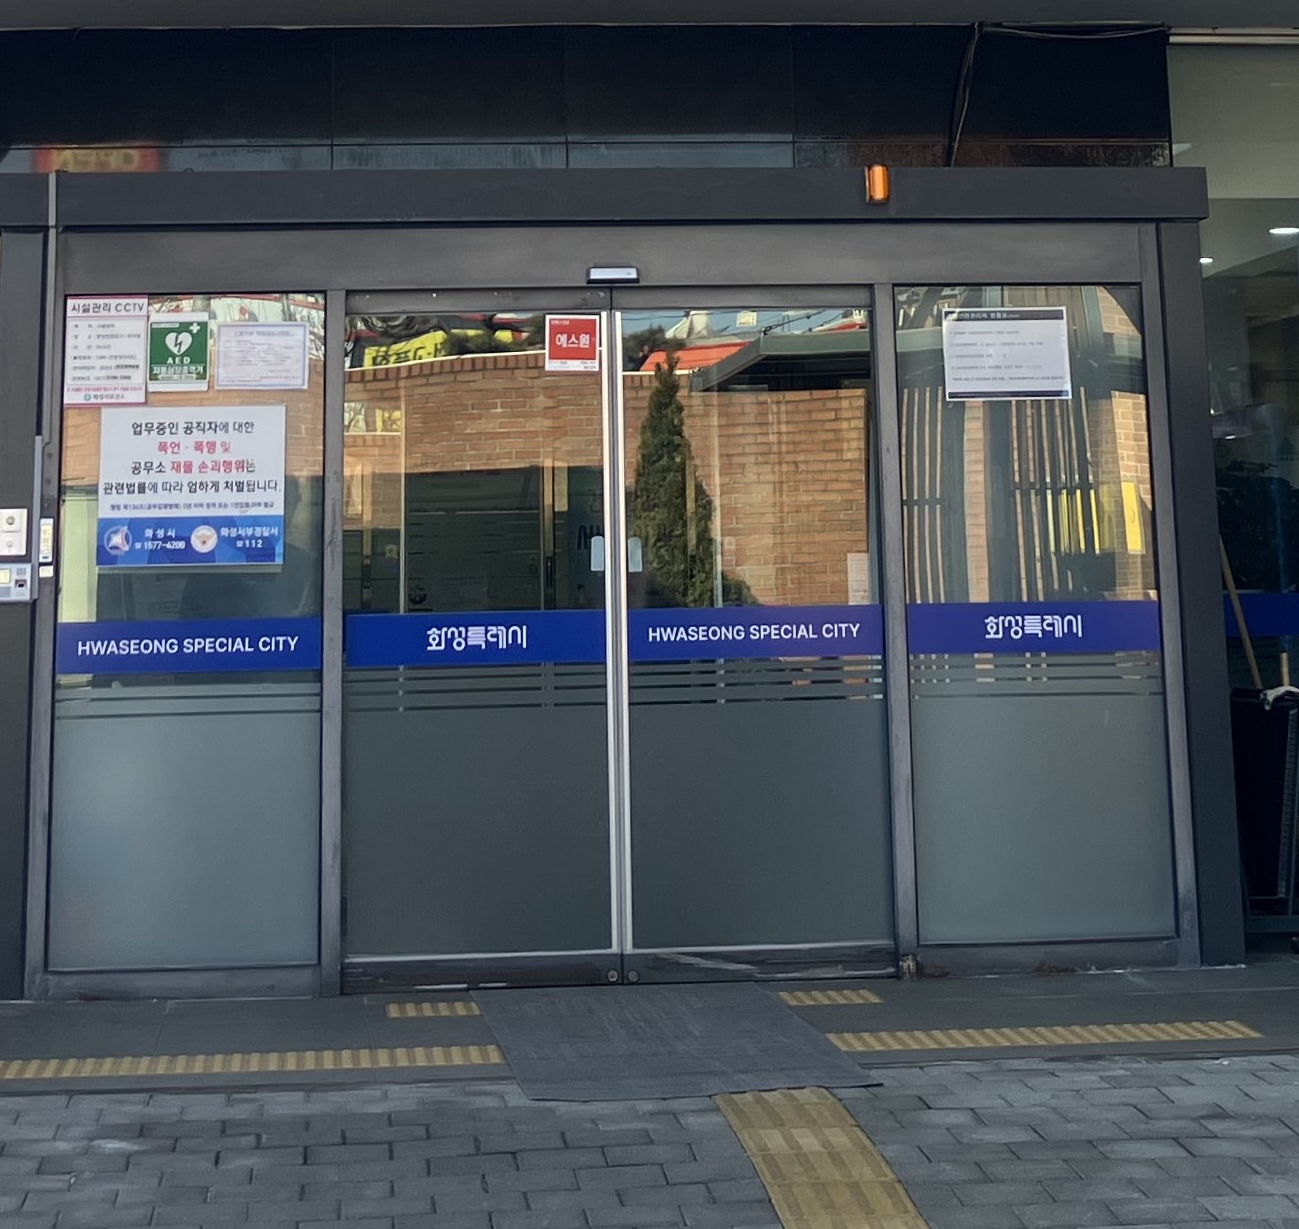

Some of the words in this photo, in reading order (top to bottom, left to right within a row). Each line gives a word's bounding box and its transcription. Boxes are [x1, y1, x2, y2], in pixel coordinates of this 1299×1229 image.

[71, 302, 111, 313] 시설관리
[115, 302, 144, 312] CCTV
[555, 333, 590, 348] 에스원
[131, 422, 179, 435] 업무중인
[183, 421, 228, 435] 공직자에
[233, 421, 254, 434] 대한
[158, 441, 181, 454] 폭언
[193, 441, 217, 454] 폭행
[220, 441, 231, 454] 및
[132, 461, 165, 474] 공무소
[170, 460, 194, 474] 재물
[198, 459, 256, 474] 손괴행위는
[103, 481, 158, 495] 관련법률에
[162, 481, 183, 493] 따라
[187, 481, 220, 494] 엄하게
[245, 539, 263, 548] 112
[649, 626, 745, 641] HWASEONG
[750, 624, 817, 639] SPECIAL
[822, 623, 860, 638] CITY
[985, 615, 1082, 639] 화성특례시
[427, 624, 526, 650] 화성특례시
[78, 637, 179, 655] HWASEONG
[183, 637, 254, 653] SPECIAL
[259, 636, 298, 651] CITY
